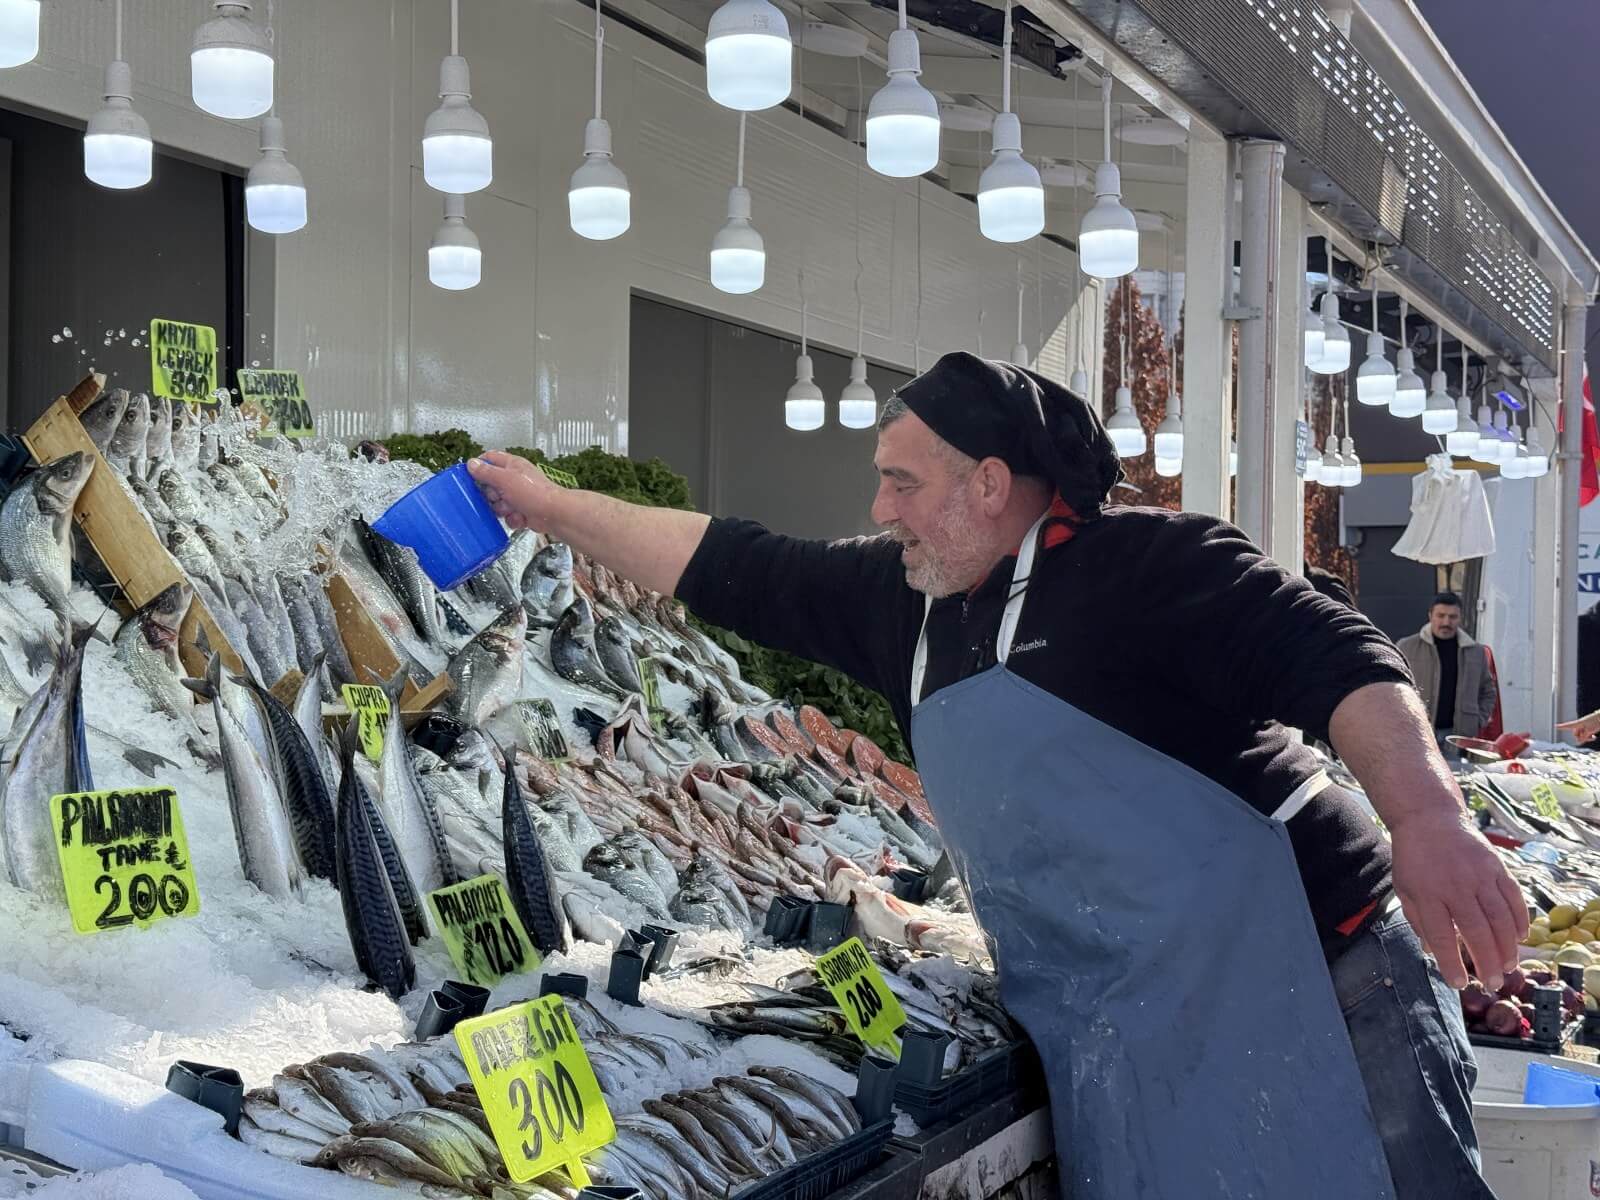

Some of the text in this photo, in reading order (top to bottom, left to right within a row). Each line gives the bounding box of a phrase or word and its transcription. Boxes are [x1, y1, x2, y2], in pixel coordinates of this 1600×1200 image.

[94, 873, 189, 929] 200
[474, 916, 525, 976] 120
[845, 975, 883, 1029] 200
[508, 1060, 585, 1162] 300
